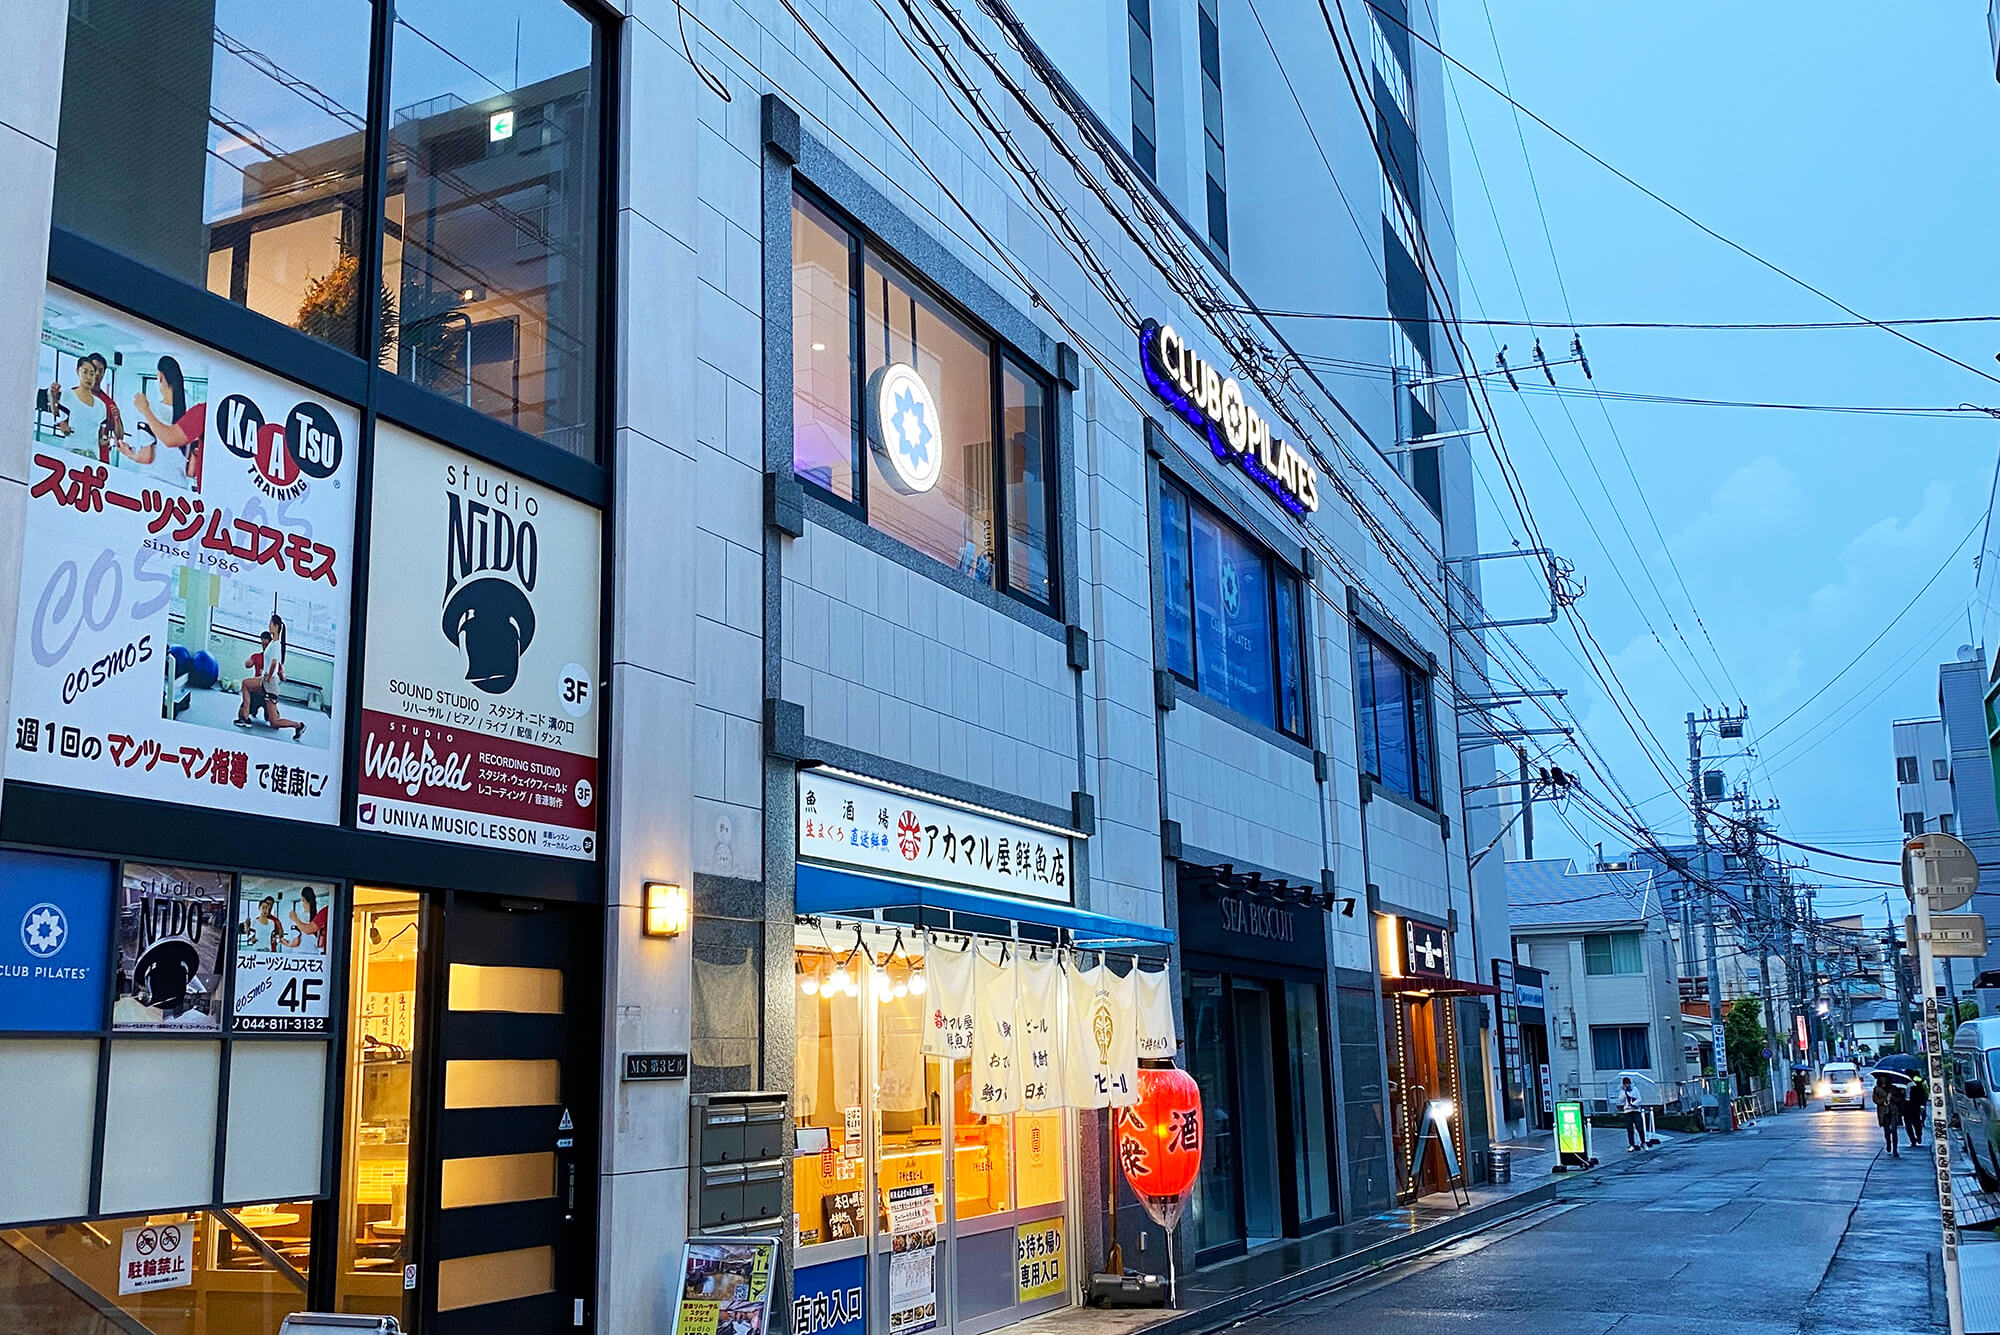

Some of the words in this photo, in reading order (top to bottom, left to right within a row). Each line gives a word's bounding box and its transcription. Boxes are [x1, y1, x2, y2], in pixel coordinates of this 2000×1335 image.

[1160, 324, 1222, 422] CLUB
[1246, 405, 1319, 512] PILATES
[247, 463, 308, 501] TRAINING
[446, 464, 539, 517] studio
[31, 453, 338, 587] スポーツジムコスモス
[143, 538, 191, 560] sinse
[197, 551, 240, 574] 1986
[389, 679, 433, 701] SOUND
[437, 690, 480, 712] STUDIO
[563, 677, 588, 704] 3F
[389, 721, 454, 743] STUDIO
[365, 732, 473, 797] Wakefield
[479, 752, 529, 773] RECORDING
[530, 761, 561, 778] STUDIO
[577, 785, 591, 801] 3F
[383, 807, 429, 830] UNIVA
[431, 815, 478, 837] MUSIC
[481, 820, 537, 845] LESSON
[924, 824, 1065, 887] アカマル屋鮮魚店
[140, 878, 205, 898] studio
[1222, 896, 1249, 934] SEA
[1250, 902, 1294, 942] BISCUIT
[237, 954, 324, 973] スポーツジムコスモス
[277, 976, 324, 1013] 4F
[242, 1019, 324, 1030] 044-811-3132
[631, 1059, 648, 1073] MS
[1017, 1230, 1061, 1260] お持ち帰り
[128, 1255, 186, 1279] 駐輪禁止
[1020, 1260, 1059, 1288] 専用入口
[793, 1286, 862, 1335] 店内入口
